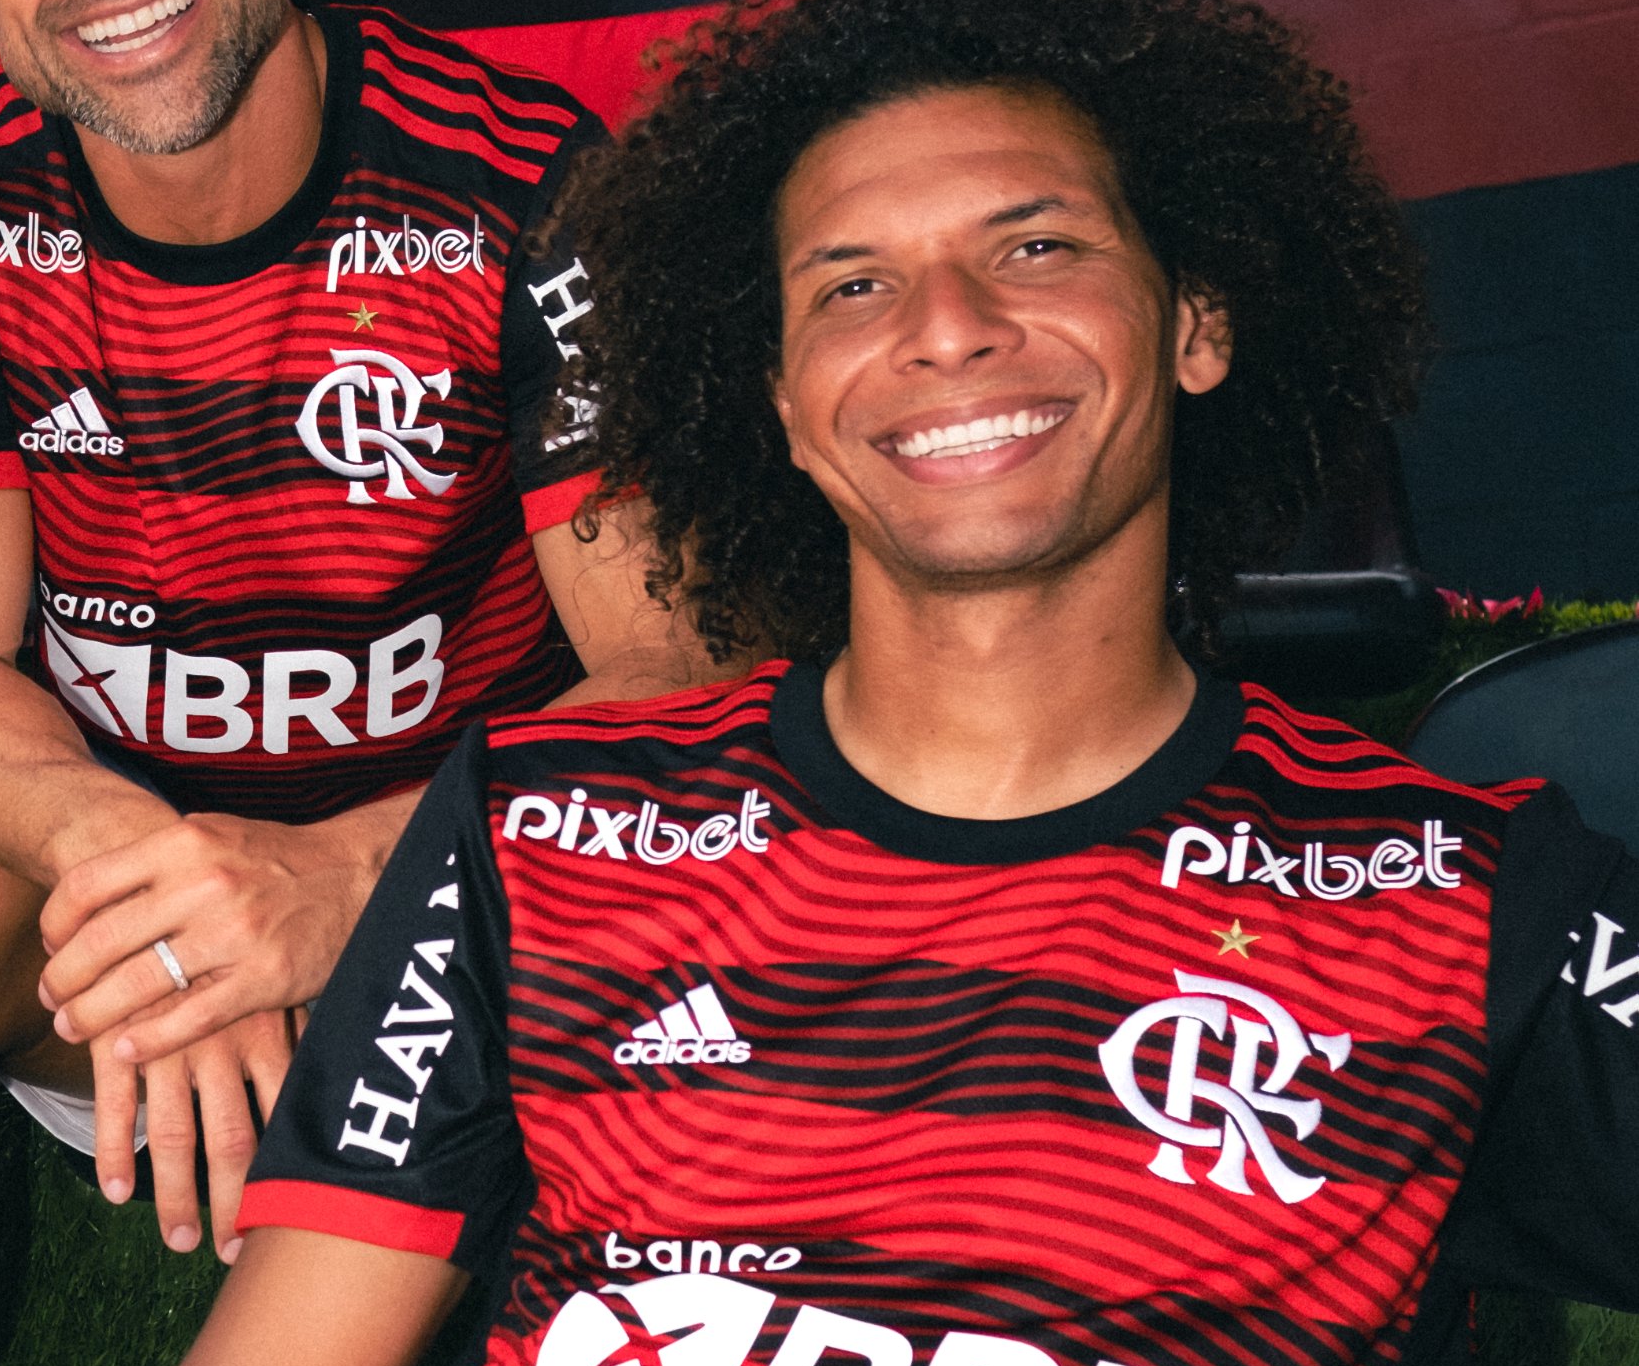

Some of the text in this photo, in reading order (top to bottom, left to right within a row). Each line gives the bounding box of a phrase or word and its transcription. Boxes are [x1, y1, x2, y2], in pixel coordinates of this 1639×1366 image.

[326, 214, 485, 293] pixbet
[18, 427, 124, 456] adidas
[162, 613, 445, 755] BRB
[502, 788, 771, 866] pixbet
[1160, 819, 1462, 901] pixbet
[613, 1038, 752, 1065] adidas
[605, 1232, 802, 1273] banco
